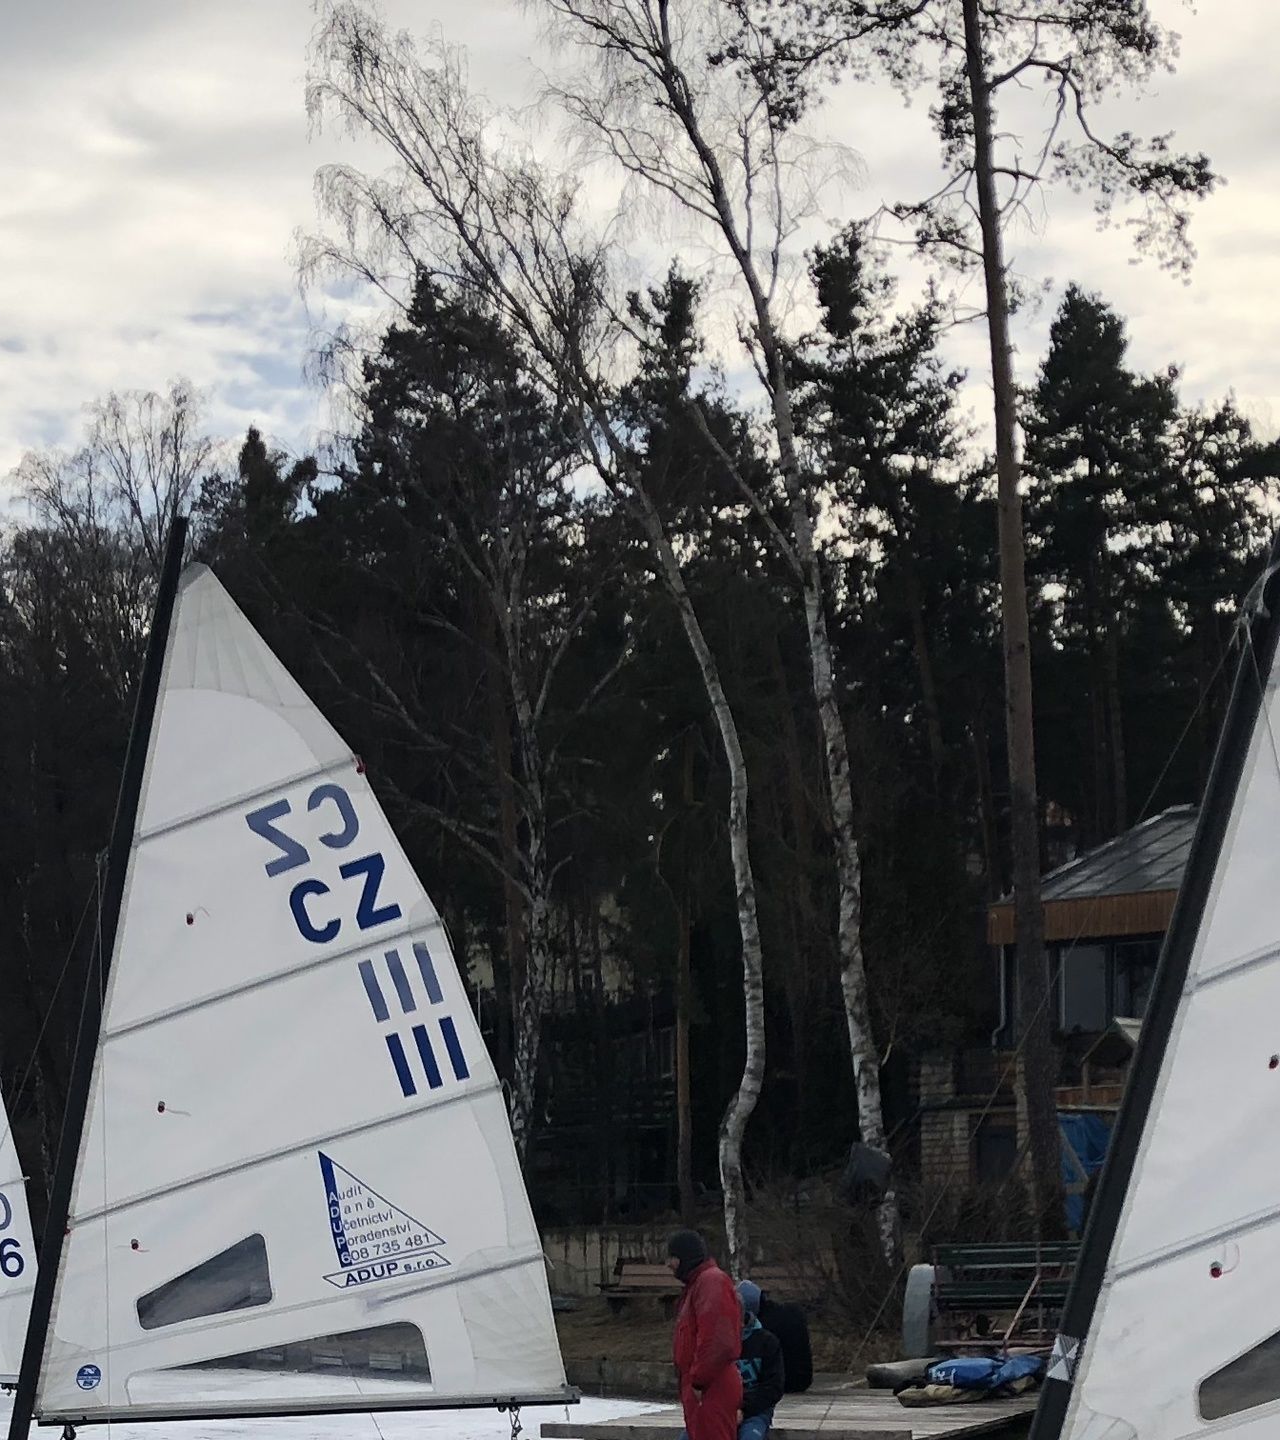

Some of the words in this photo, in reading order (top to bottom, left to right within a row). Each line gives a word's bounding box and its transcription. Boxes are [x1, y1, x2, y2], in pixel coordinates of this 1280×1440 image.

[288, 852, 402, 943] CZ
[329, 1185, 362, 1204] Audit
[336, 1220, 411, 1249] Poradenství
[340, 1247, 369, 1264] 608
[372, 1239, 401, 1256] 735
[404, 1232, 431, 1248] 481
[345, 1262, 398, 1286] ADUP
